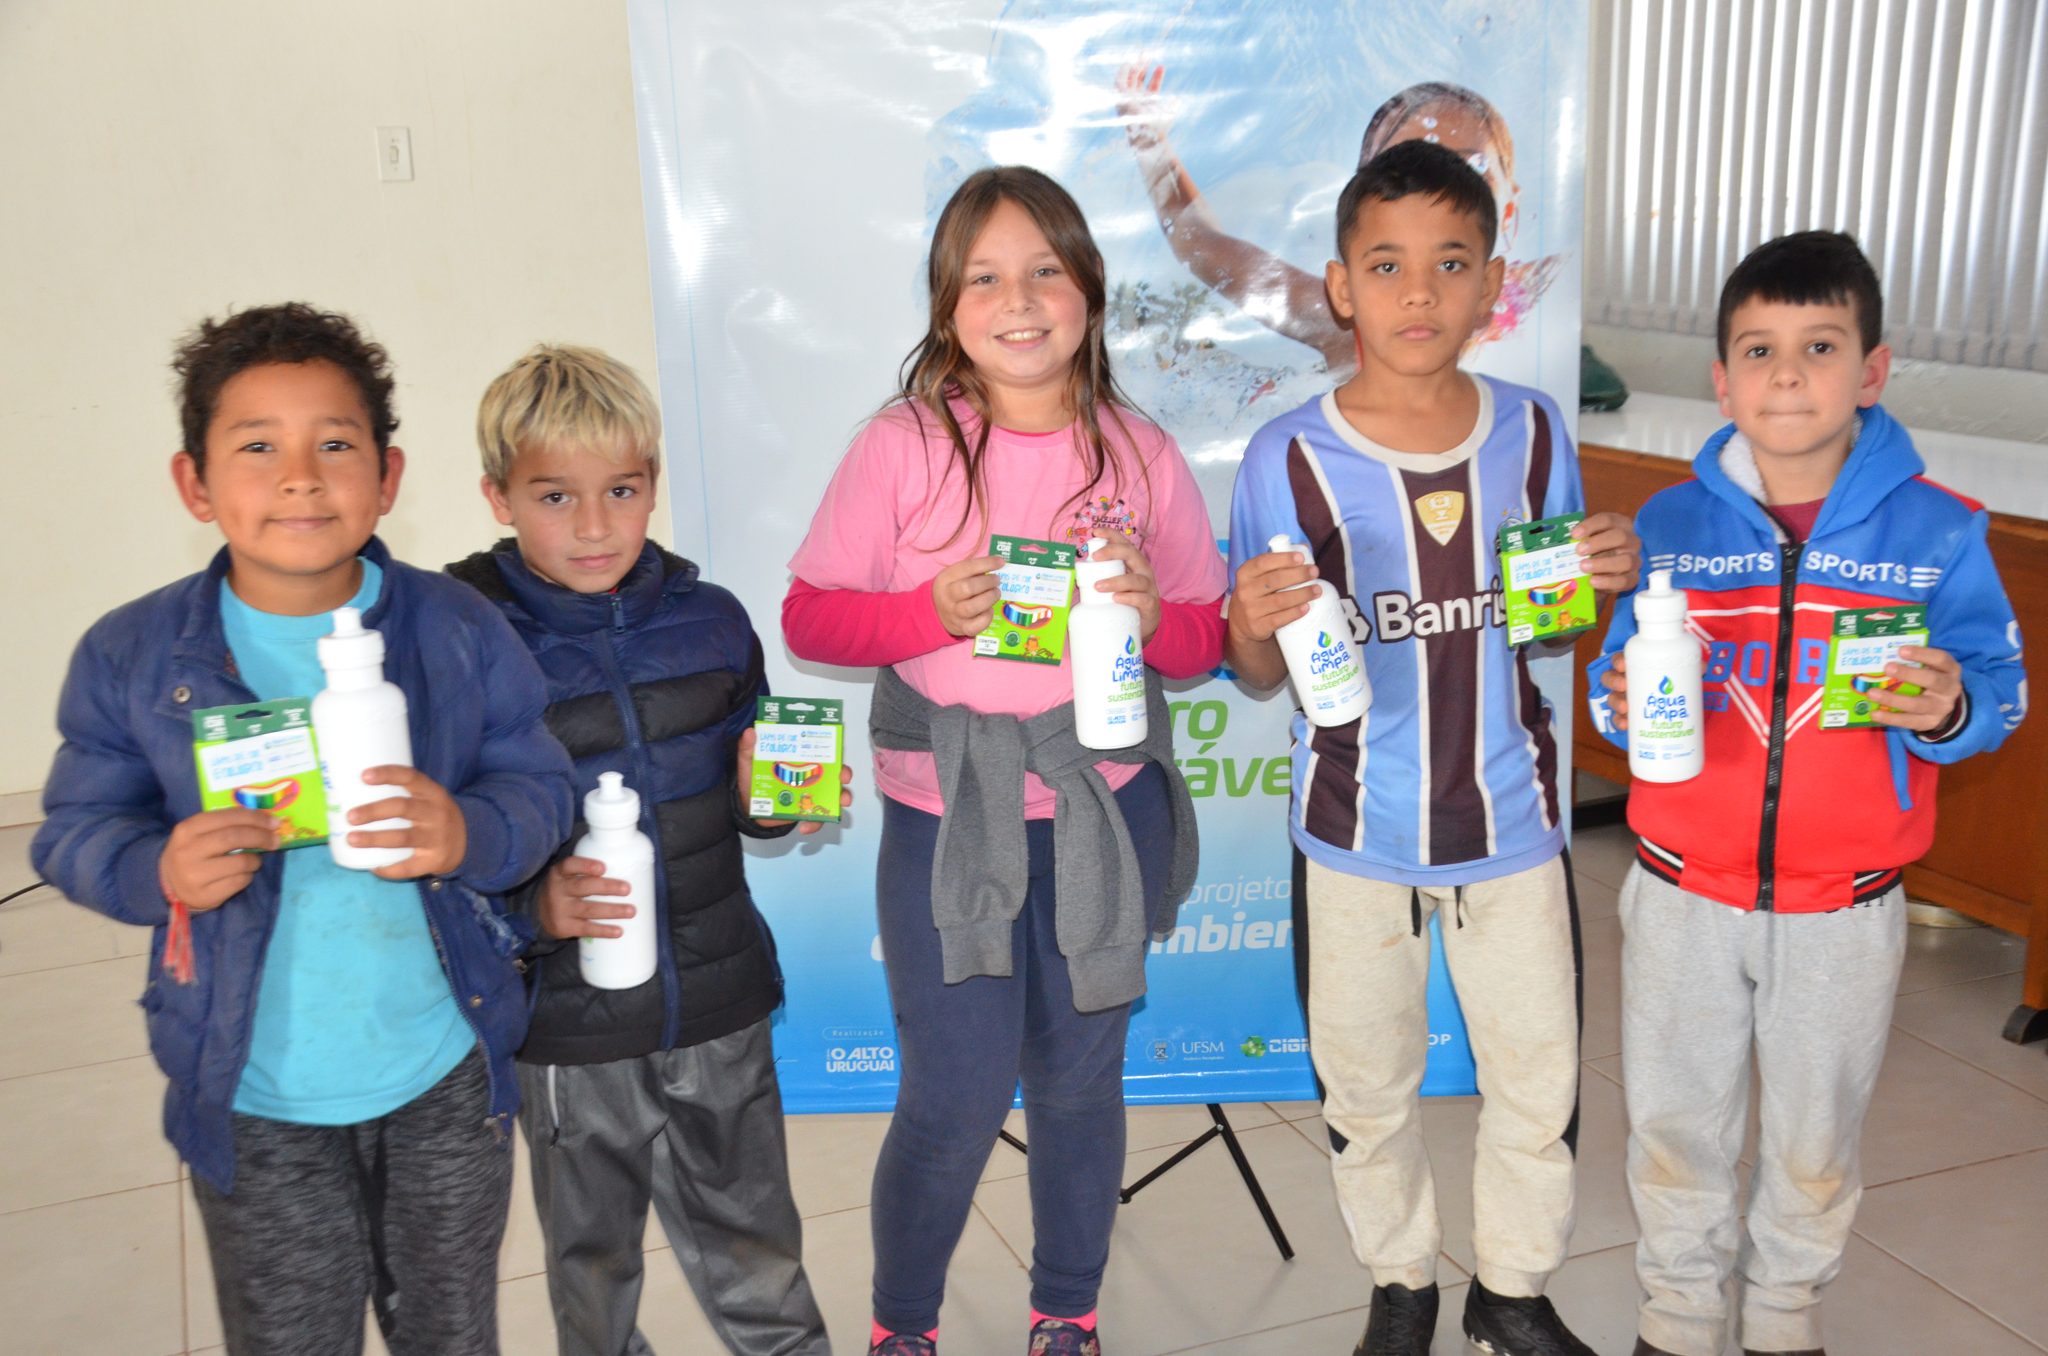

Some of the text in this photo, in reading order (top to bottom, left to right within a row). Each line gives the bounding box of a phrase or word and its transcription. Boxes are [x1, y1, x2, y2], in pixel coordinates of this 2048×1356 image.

[1678, 552, 1775, 575] SPORTS
[1804, 551, 1908, 585] SPORTS
[831, 1047, 846, 1060] O
[847, 1046, 895, 1060] ALTO
[1182, 1040, 1224, 1054] UFSM
[826, 1060, 895, 1073] URUGUAI
